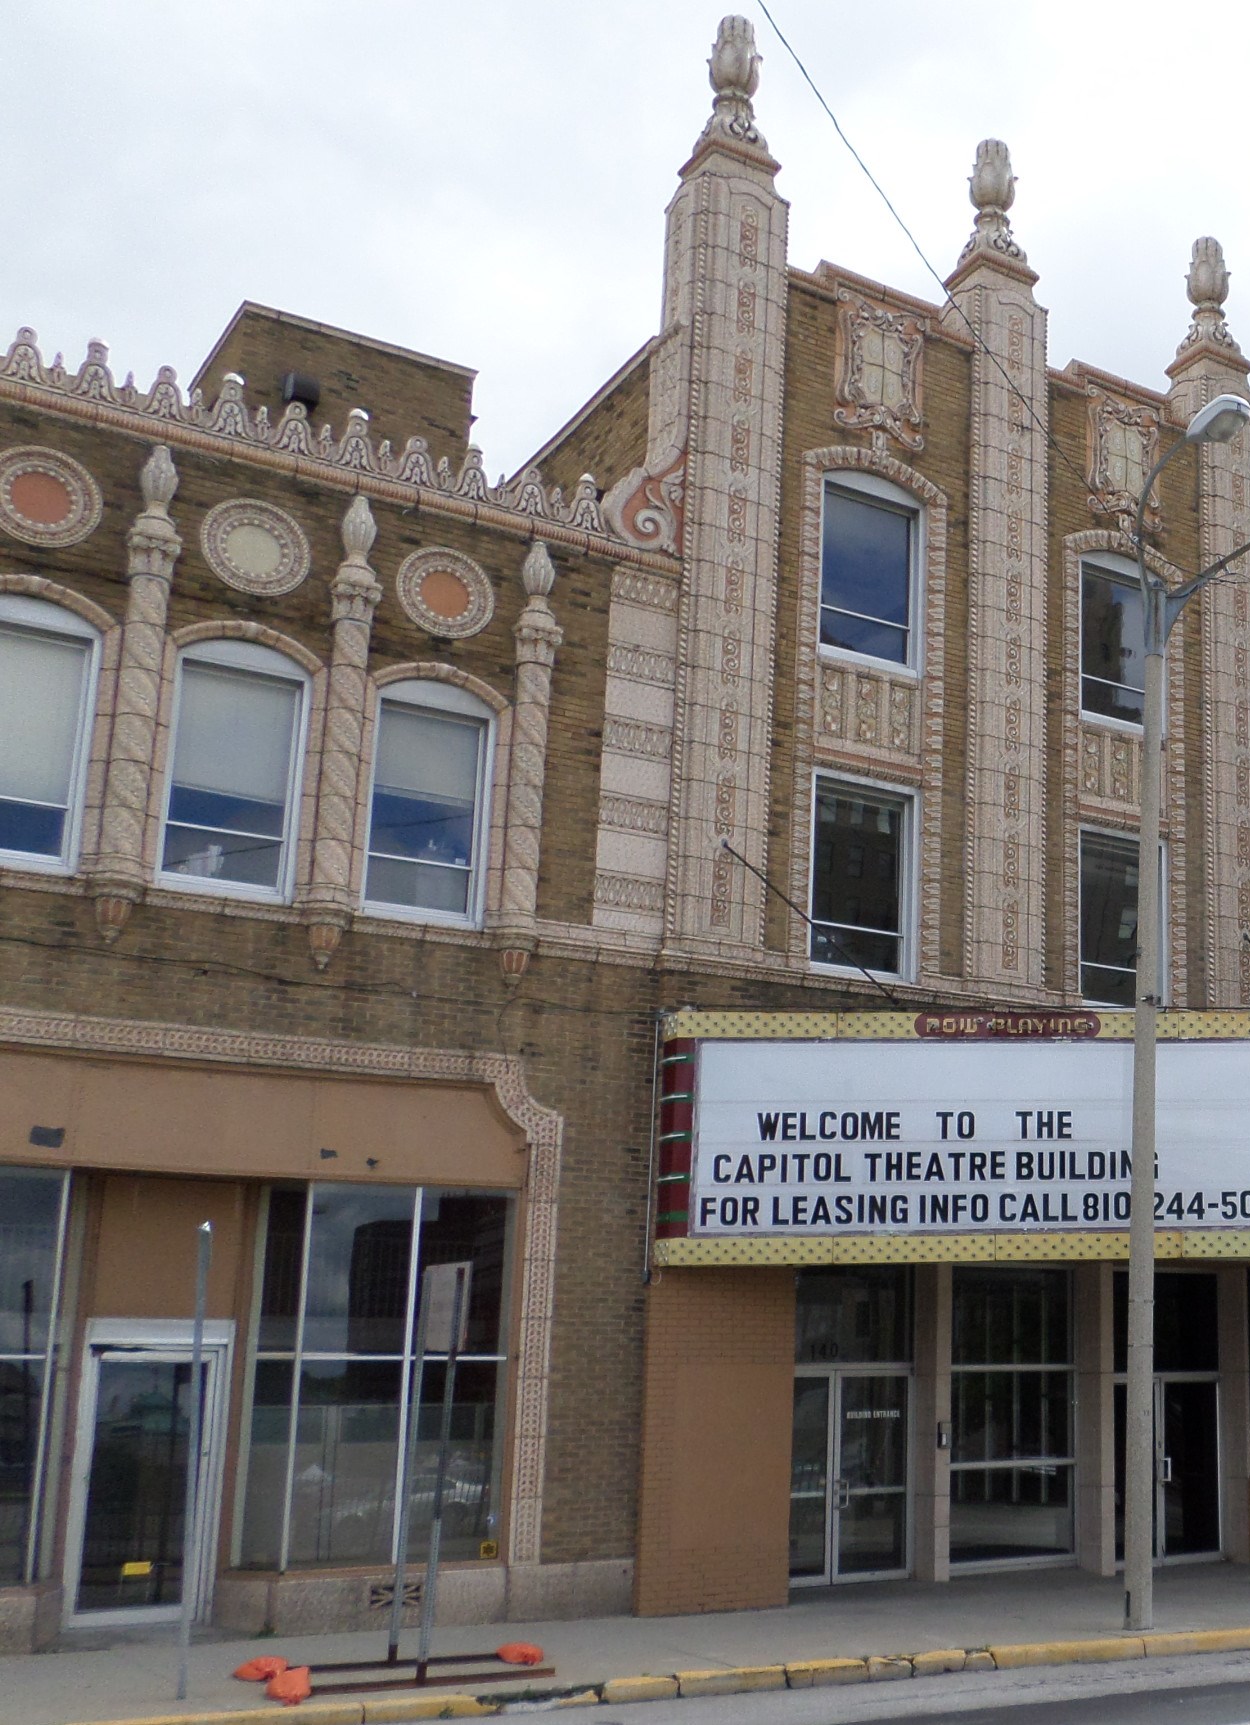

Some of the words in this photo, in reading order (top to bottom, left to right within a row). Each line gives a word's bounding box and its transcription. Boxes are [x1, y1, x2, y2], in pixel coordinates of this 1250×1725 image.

[926, 1018, 977, 1033] NOW
[991, 1018, 1088, 1034] PLAYING
[757, 1110, 901, 1141] WELCOME
[936, 1110, 975, 1140] TO
[1015, 1110, 1073, 1140] THE
[713, 1153, 852, 1184] CAPITOL
[864, 1151, 1006, 1182] THEATRE
[1015, 1150, 1159, 1180] BUILDIN
[700, 1196, 760, 1227] FOR
[772, 1194, 909, 1226] LEASING
[919, 1194, 989, 1224] INFO
[999, 1193, 1078, 1223] CALL
[810, 1342, 839, 1360] 140
